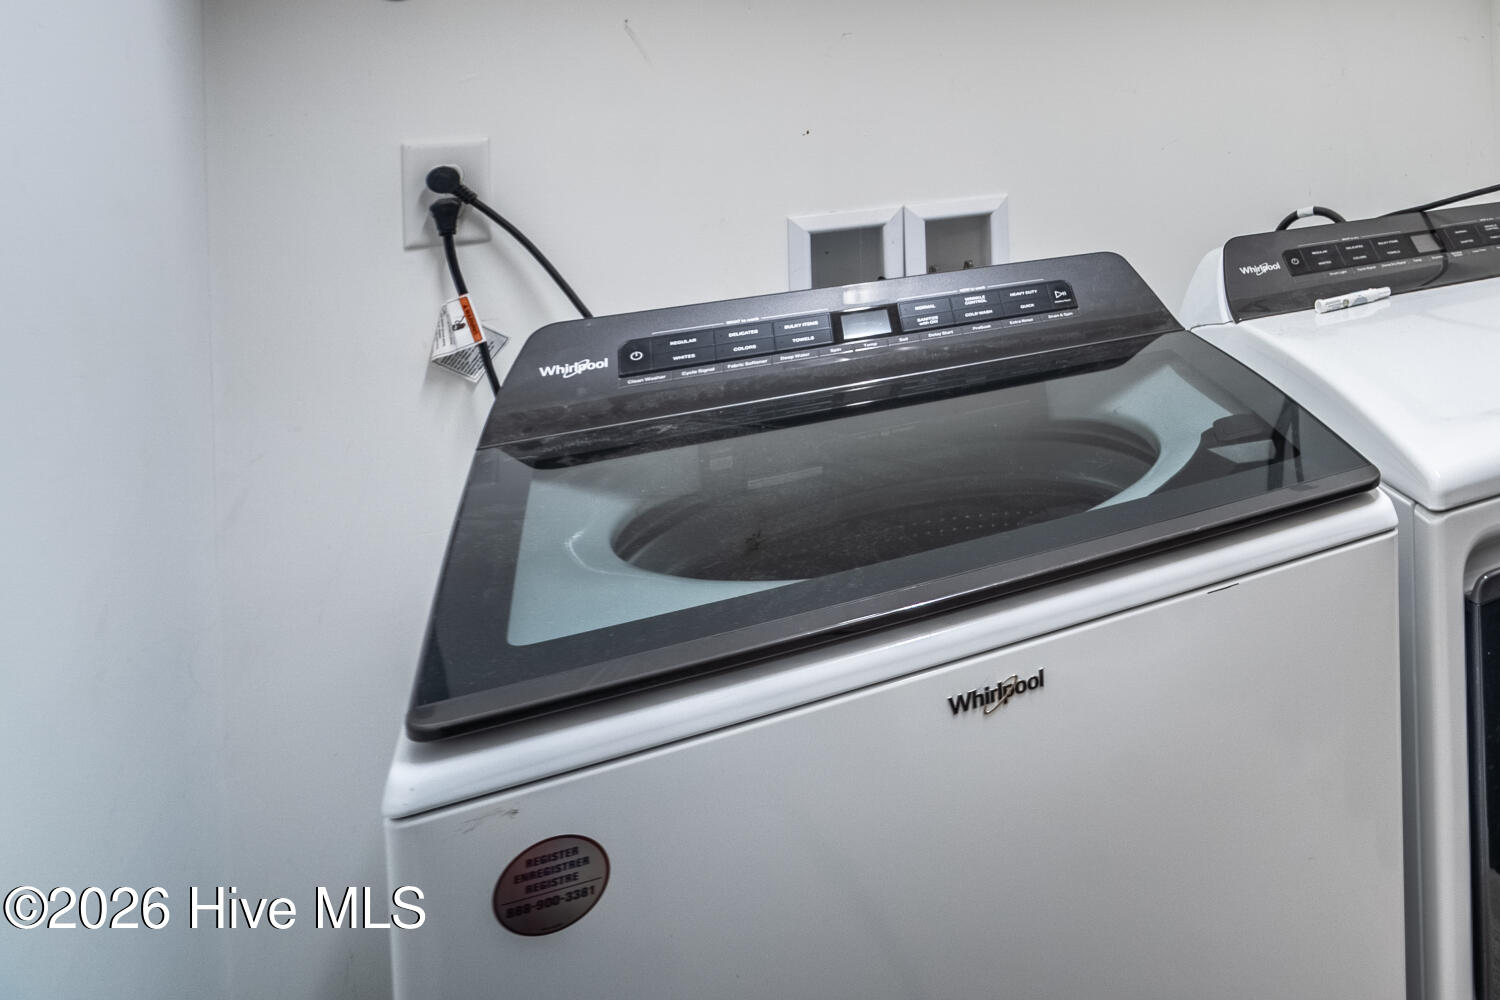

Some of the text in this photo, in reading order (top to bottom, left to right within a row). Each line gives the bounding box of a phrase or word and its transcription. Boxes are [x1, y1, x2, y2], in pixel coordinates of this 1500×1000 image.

[1239, 262, 1281, 276] Whirlpool
[784, 320, 819, 330] BULKY ITEMS
[728, 329, 759, 338] DELICATES
[669, 338, 697, 346] REGULAR
[792, 335, 815, 343] TOWELS
[733, 344, 757, 352] COLORS
[672, 353, 696, 361] WHITES
[539, 358, 609, 379] Whirlpool
[727, 361, 744, 369] Fabric
[681, 369, 697, 377] Cycle
[644, 374, 666, 382] Washer
[947, 667, 1045, 715] Whirlpool
[525, 846, 580, 868] REGISTER
